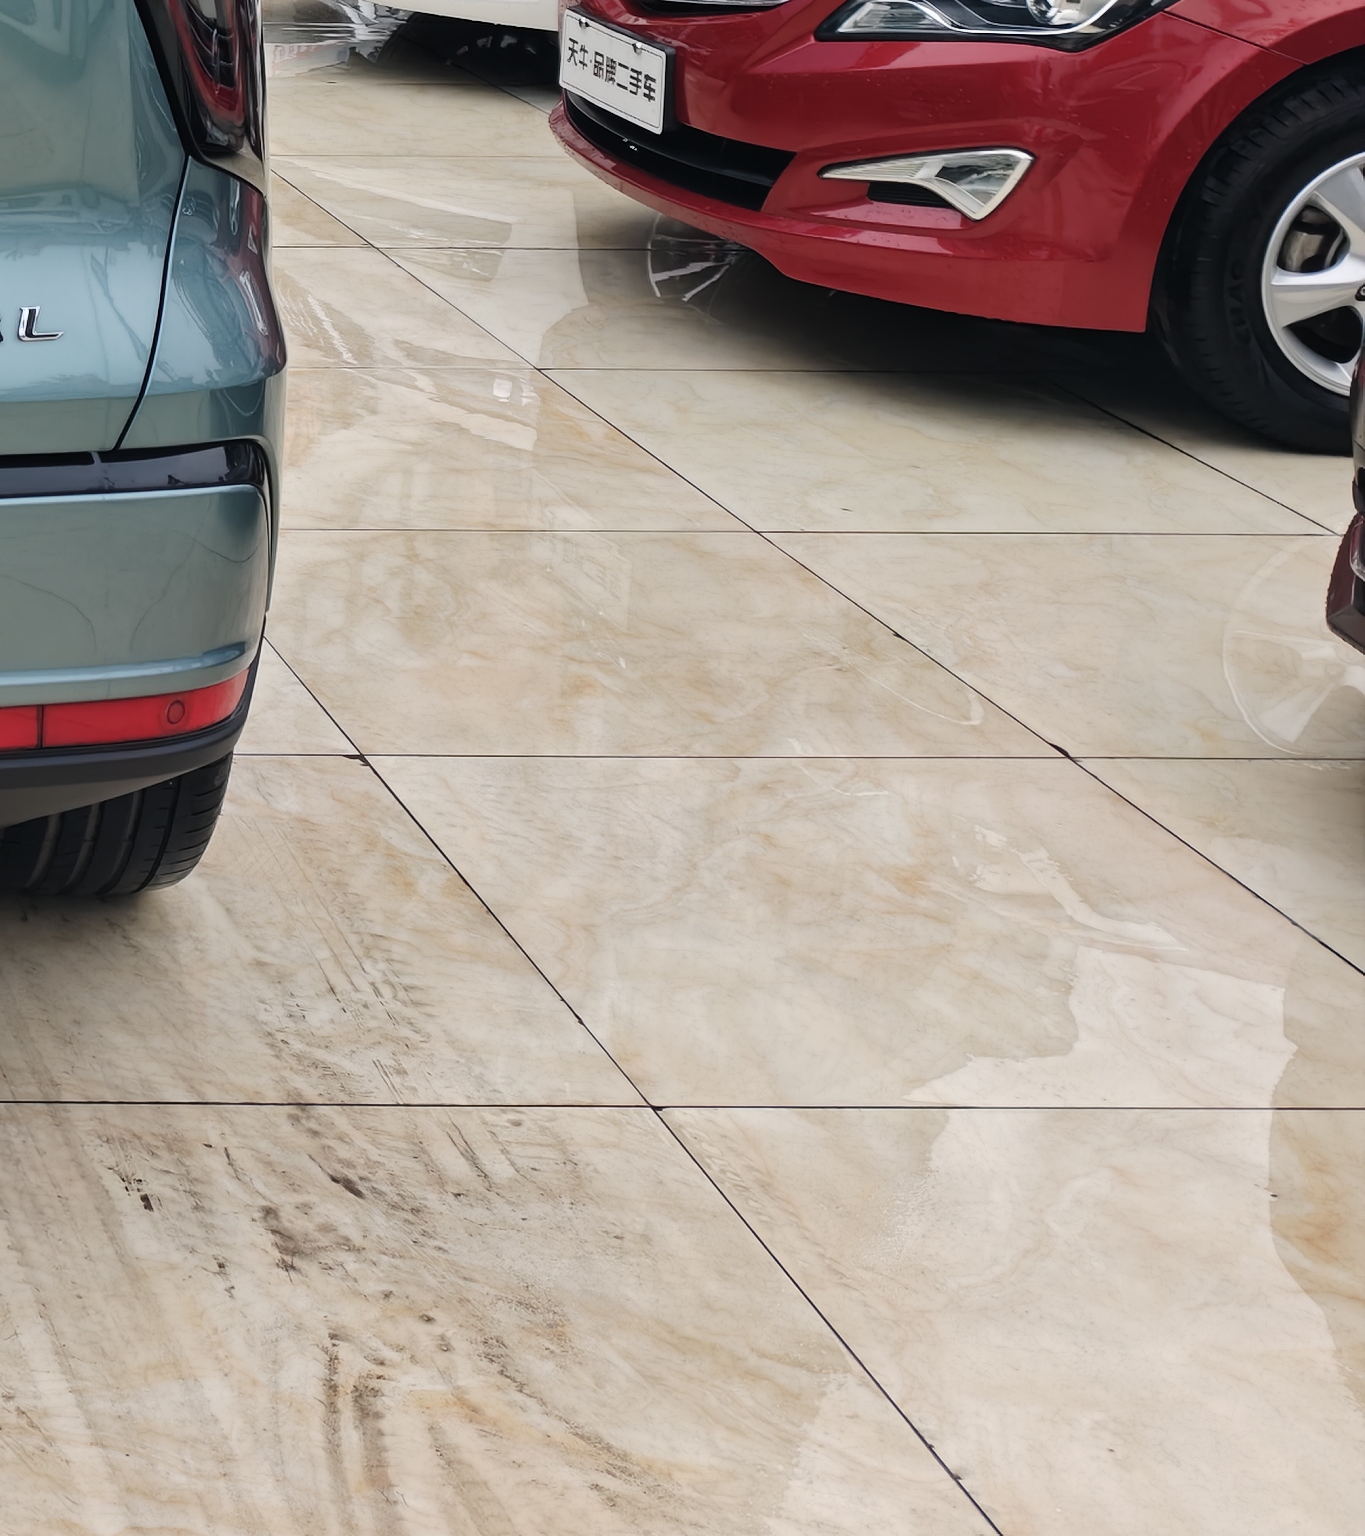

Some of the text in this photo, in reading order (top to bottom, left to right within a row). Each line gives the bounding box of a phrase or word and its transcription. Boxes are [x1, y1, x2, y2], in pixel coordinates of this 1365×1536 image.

[566, 37, 658, 104] 天牛·品牌二手车
[17, 305, 65, 342] L
